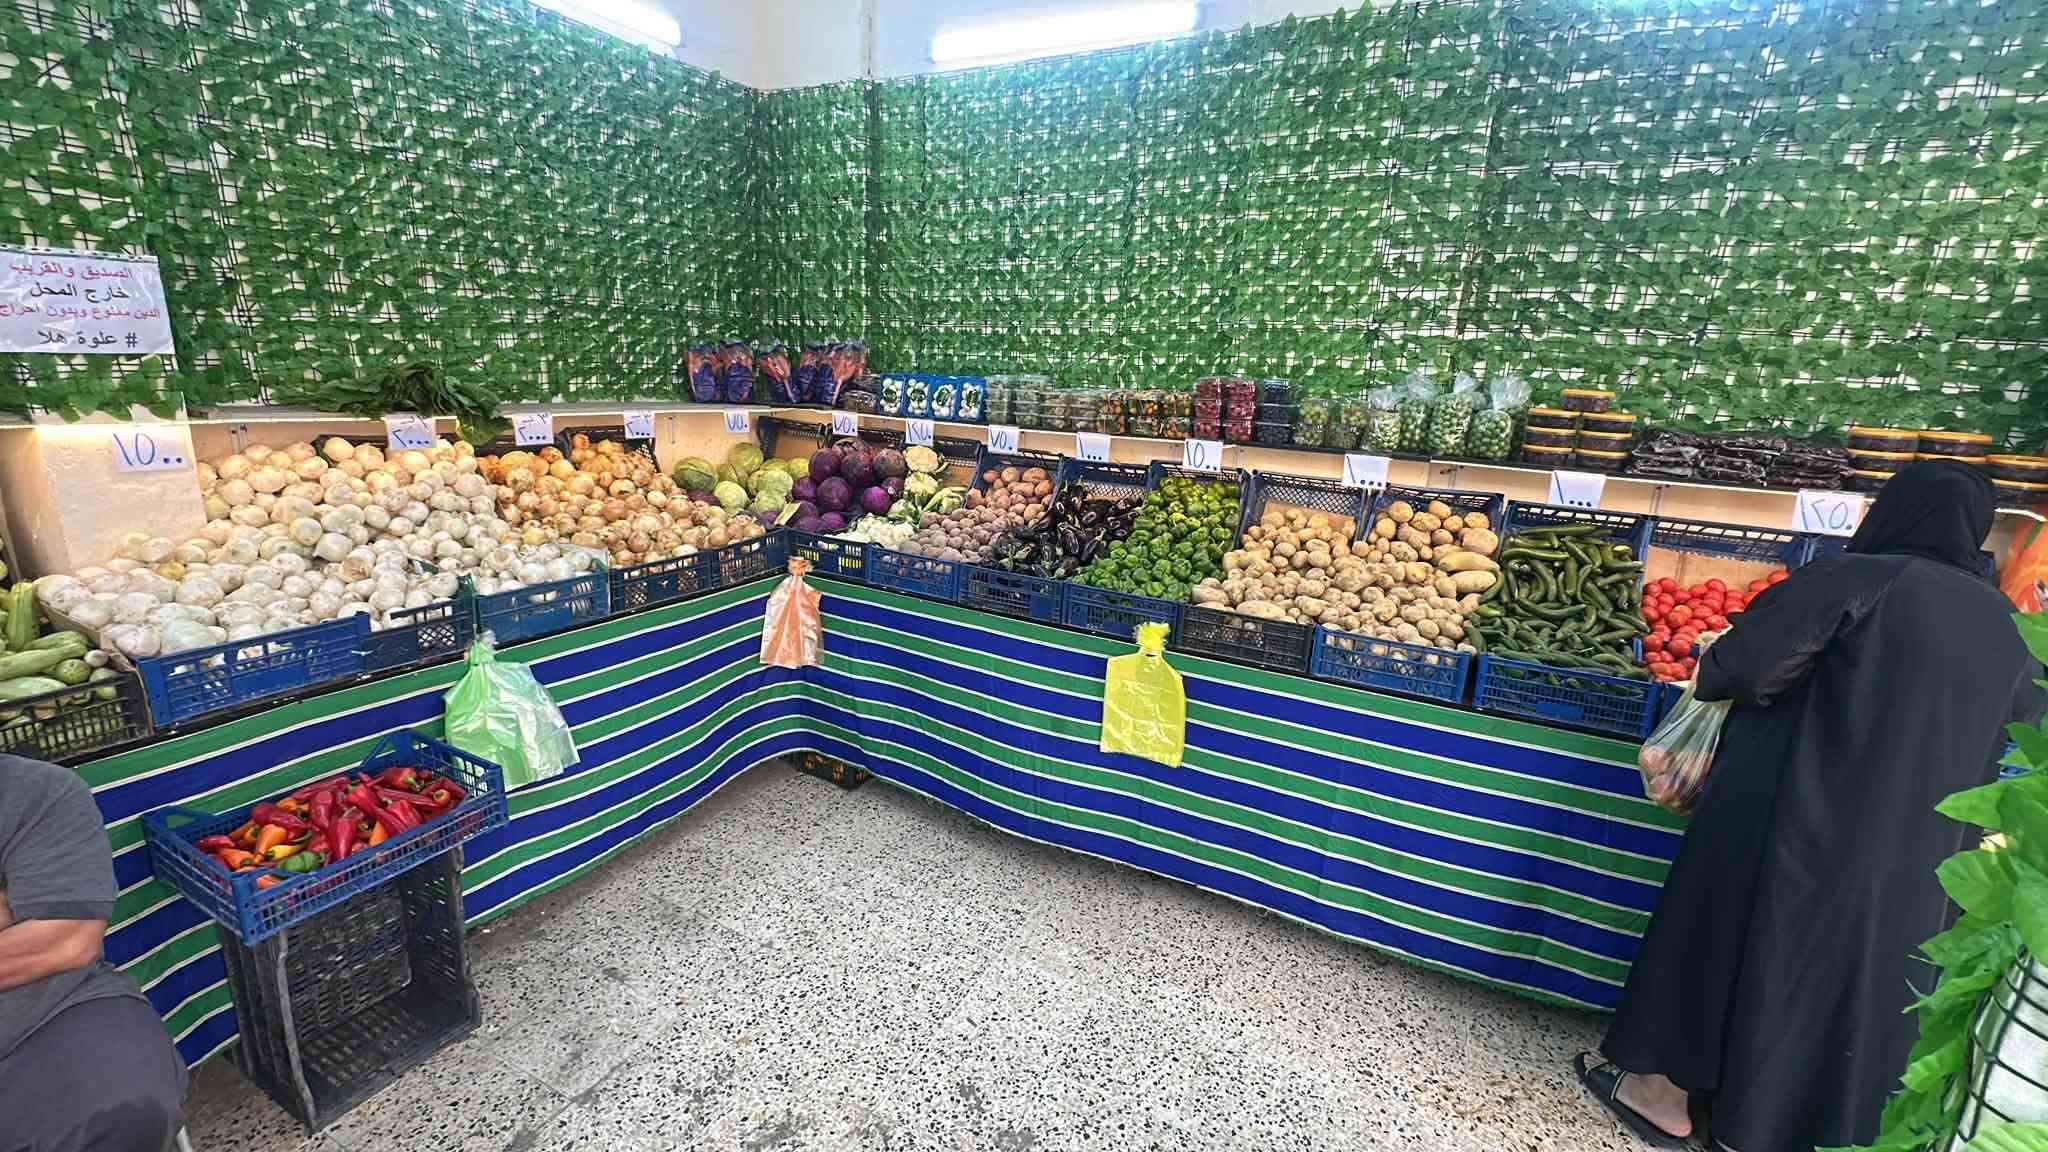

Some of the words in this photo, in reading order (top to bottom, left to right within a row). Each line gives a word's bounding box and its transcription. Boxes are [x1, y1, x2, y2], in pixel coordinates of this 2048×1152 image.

[30, 282, 77, 297] المحل
[85, 286, 129, 303] خارج
[76, 330, 117, 349] علوة
